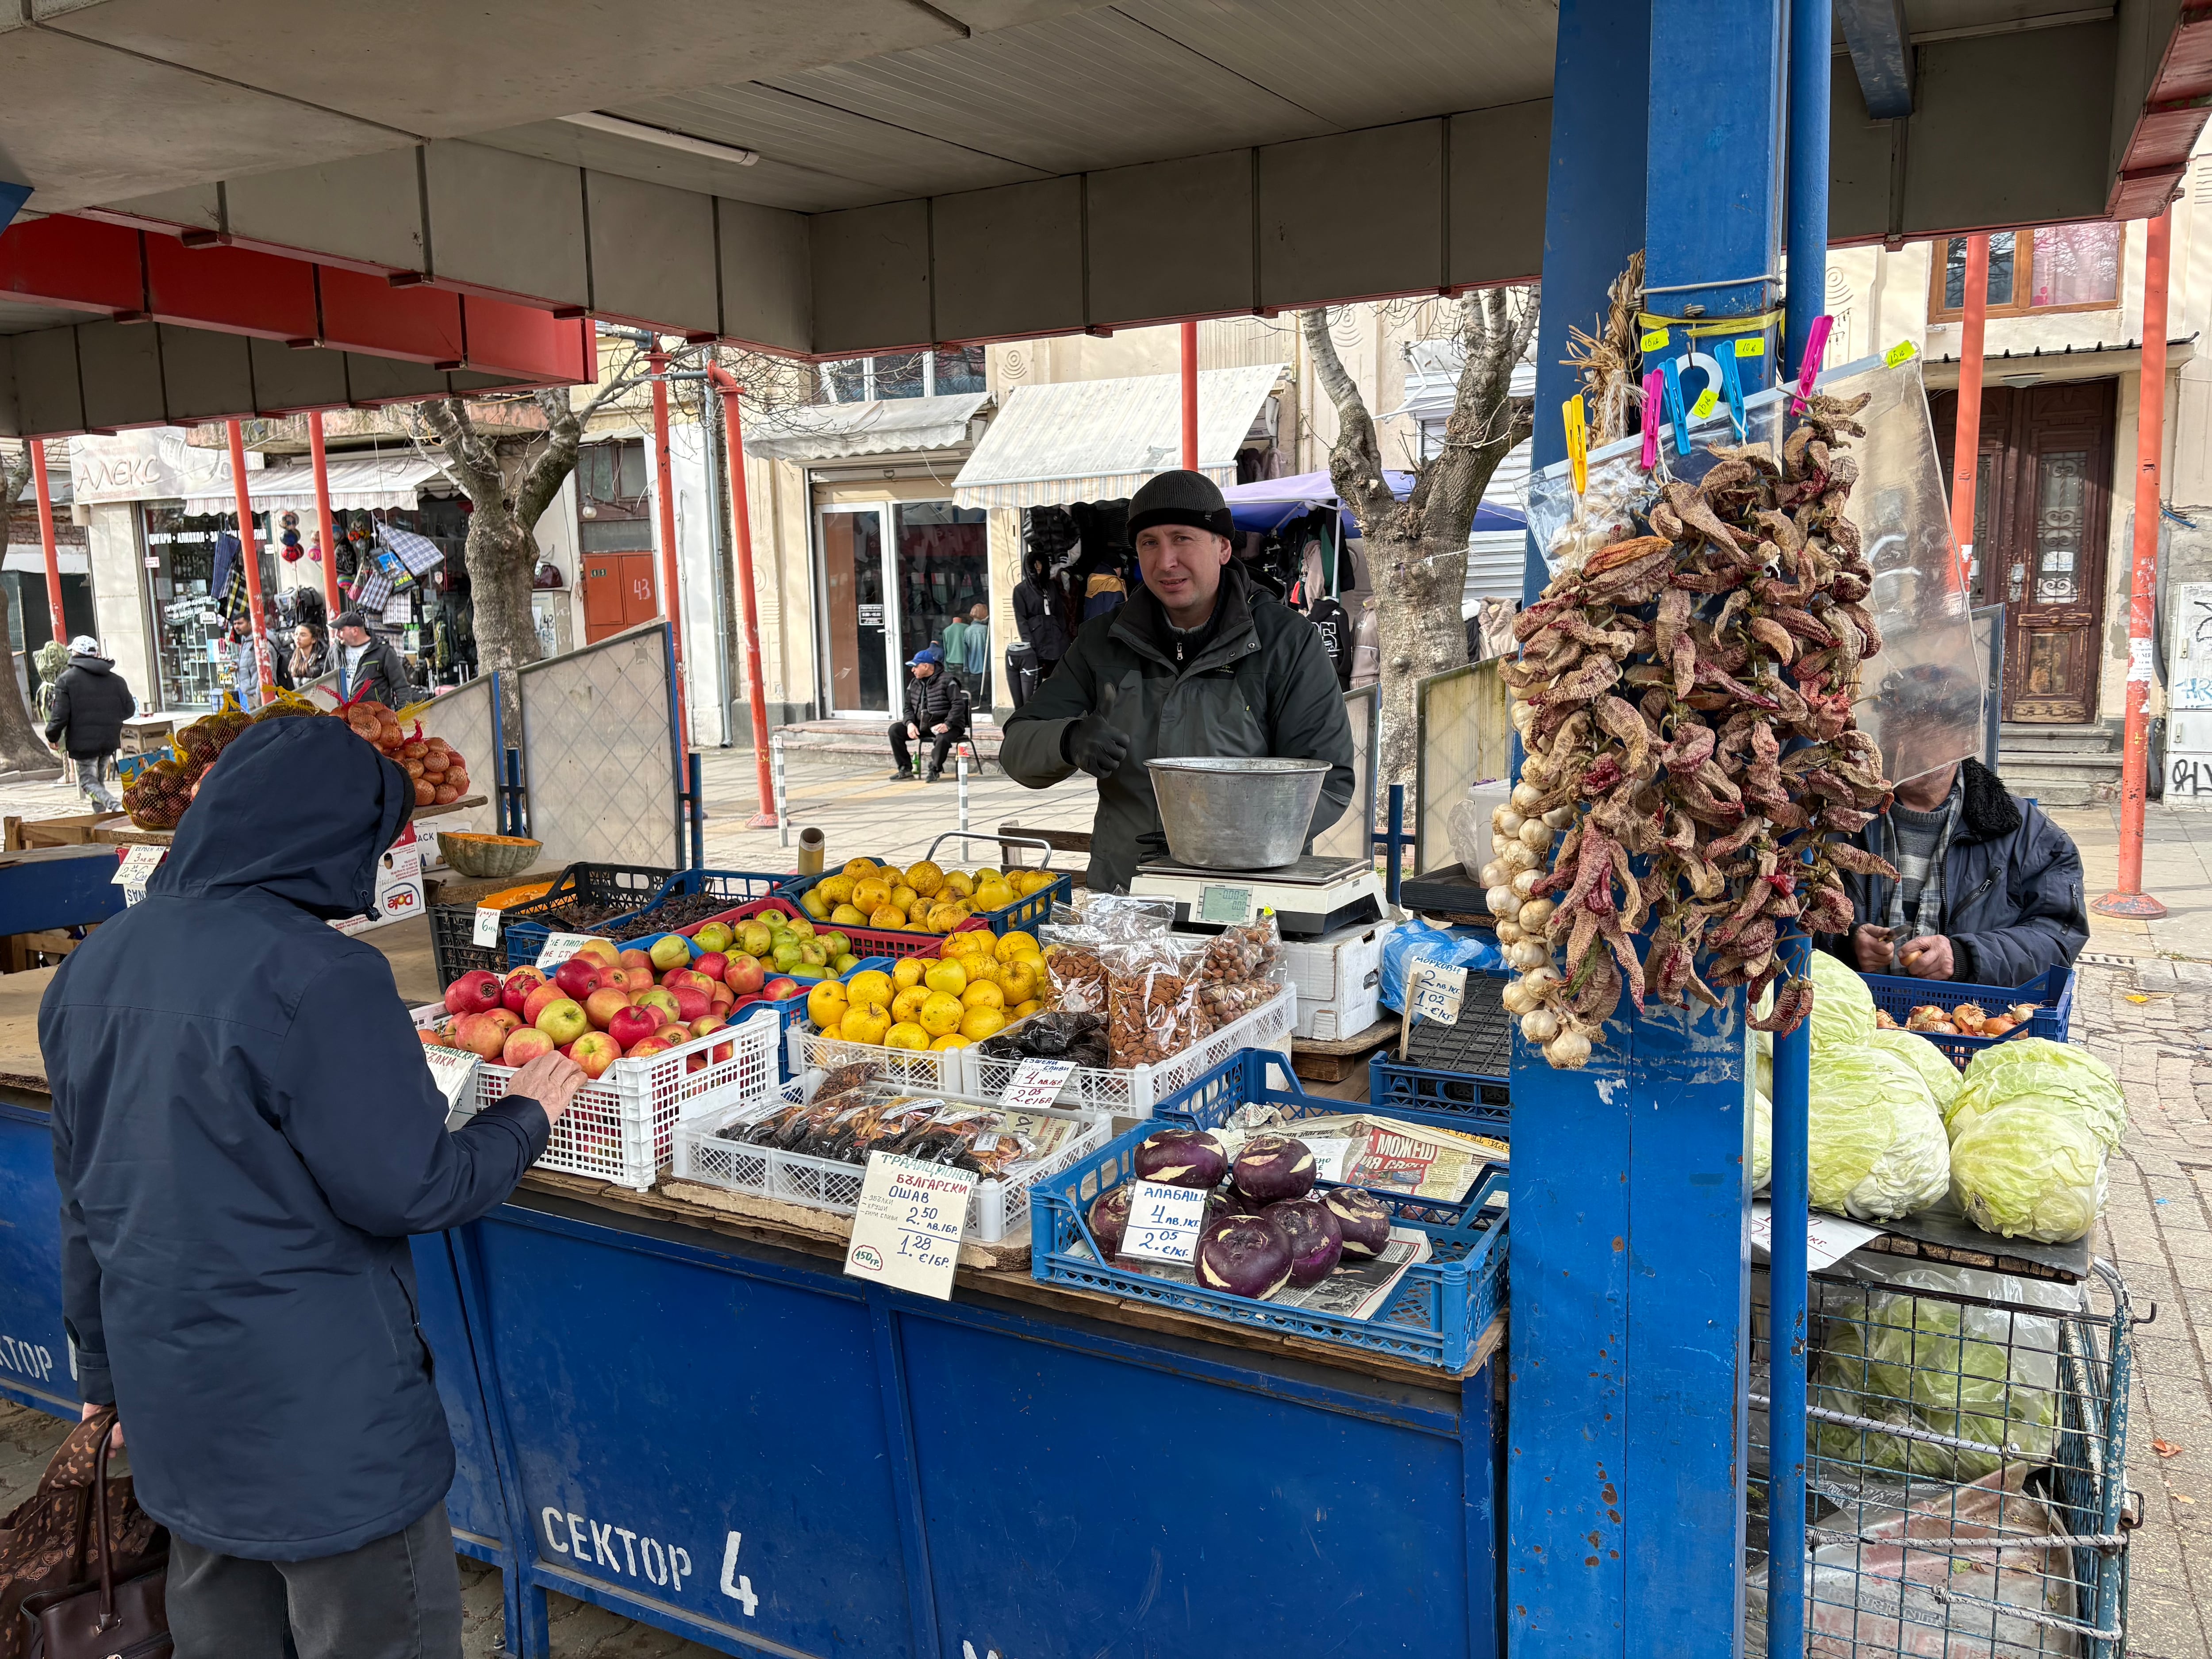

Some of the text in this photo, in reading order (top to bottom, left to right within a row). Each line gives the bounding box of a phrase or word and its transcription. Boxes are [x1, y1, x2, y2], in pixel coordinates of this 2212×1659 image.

[77, 454, 161, 492] АЛЕКС
[149, 533, 172, 545] ЦИГАРИ
[177, 531, 205, 544] АЛКОХОЛ
[634, 578, 651, 600] 43
[134, 853, 142, 862] 3
[388, 893, 413, 910] Dole
[482, 918, 488, 932] 6
[1414, 956, 1461, 975] МОРКОВИ
[1421, 970, 1436, 987] 2
[1375, 1133, 1436, 1161] МОЖЕШ
[881, 1154, 975, 1182] ТРАДИЦИОНЕН
[896, 1174, 968, 1195] БЪЛГАРСКИ
[888, 1186, 929, 1204] ОШАВ
[1144, 1187, 1204, 1202] АЛАБАШ
[867, 1202, 888, 1212] КРУШИ
[879, 1212, 899, 1221] СЛИВИ
[542, 1506, 759, 1617] СЕКТОР 4
